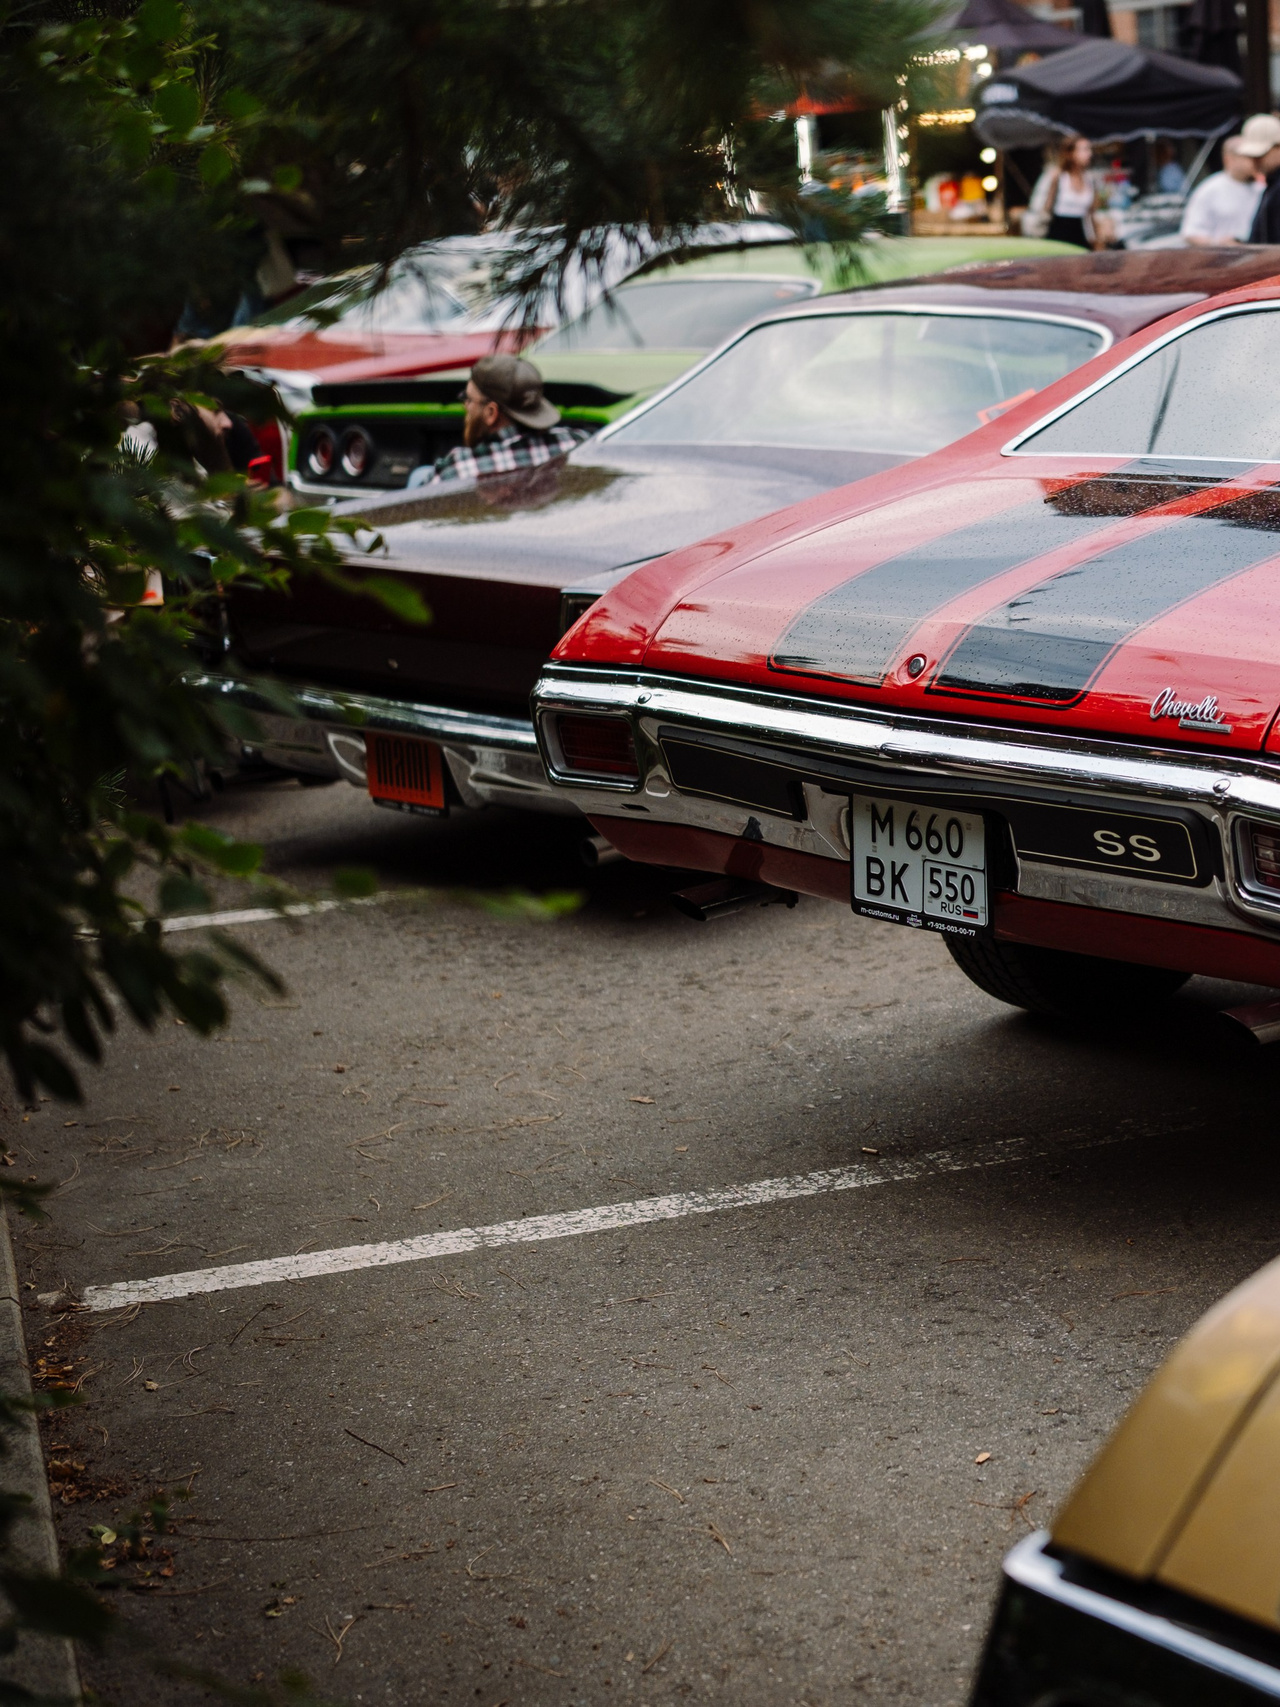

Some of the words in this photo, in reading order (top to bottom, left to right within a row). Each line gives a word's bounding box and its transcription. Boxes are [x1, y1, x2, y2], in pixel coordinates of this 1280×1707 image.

[1149, 686, 1226, 724] Chevelle
[905, 809, 964, 859] 660
[1093, 829, 1162, 862] SS
[928, 866, 975, 905] 550
[860, 906, 900, 921] m-customs.ru
[940, 901, 962, 916] RUS
[927, 921, 976, 937] +7-925-003-00-77
